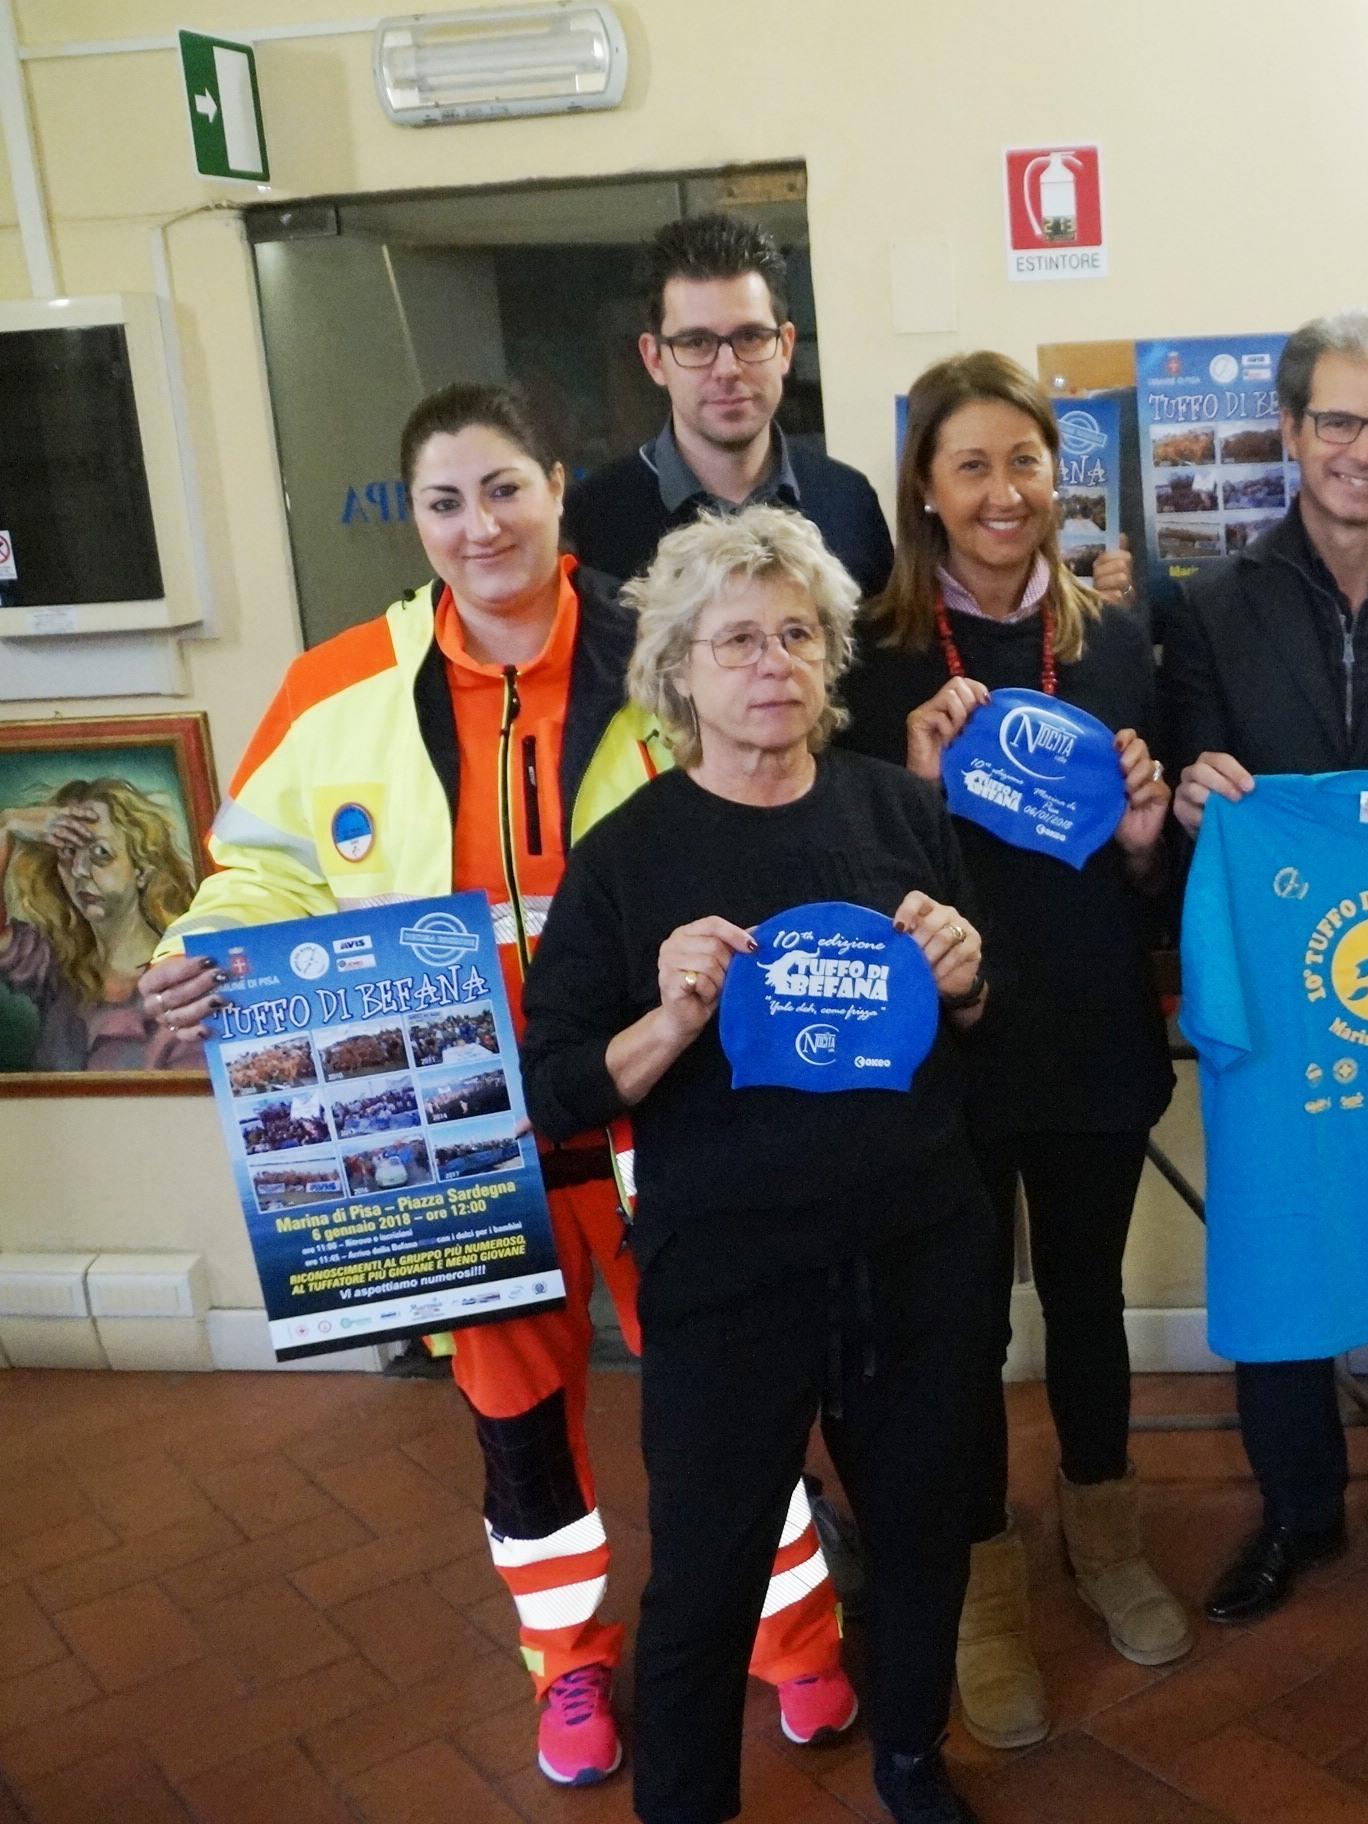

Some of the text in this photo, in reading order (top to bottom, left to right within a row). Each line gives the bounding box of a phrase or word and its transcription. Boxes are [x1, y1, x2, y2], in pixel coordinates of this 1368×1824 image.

[1016, 252, 1101, 272] ESTINTORE
[1148, 393, 1219, 421] TUFFO
[1225, 391, 1248, 418] DI
[340, 939, 366, 950] AVIS
[818, 933, 886, 955] edizione
[1305, 899, 1357, 965] TUFFO
[259, 975, 281, 987] PISA
[797, 959, 890, 980] TUFFO DI
[213, 965, 490, 1039] TUFFO DI BEFANA
[788, 974, 888, 1001] BEFANA
[276, 1214, 329, 1232] Marina
[333, 1208, 346, 1222] di
[350, 1205, 381, 1220] Pisa
[397, 1194, 444, 1211] Piazza
[447, 1181, 516, 1202] Sardegna
[312, 1229, 321, 1240] 6
[324, 1220, 376, 1241] gennaio
[379, 1213, 410, 1229] 2018
[426, 1209, 447, 1221] ore
[451, 1200, 487, 1217] 12:00
[290, 1260, 382, 1285] RICONOSCIMENTI
[383, 1258, 397, 1268] AL
[399, 1249, 442, 1265] GRUPPO
[444, 1244, 463, 1258] PIÙ
[291, 1245, 526, 1295] AL TUFFATORE PIÙ GIOVANE E MENO GIOVANE
[340, 1264, 486, 1299] Vi aspettiamo numerosi!!!
